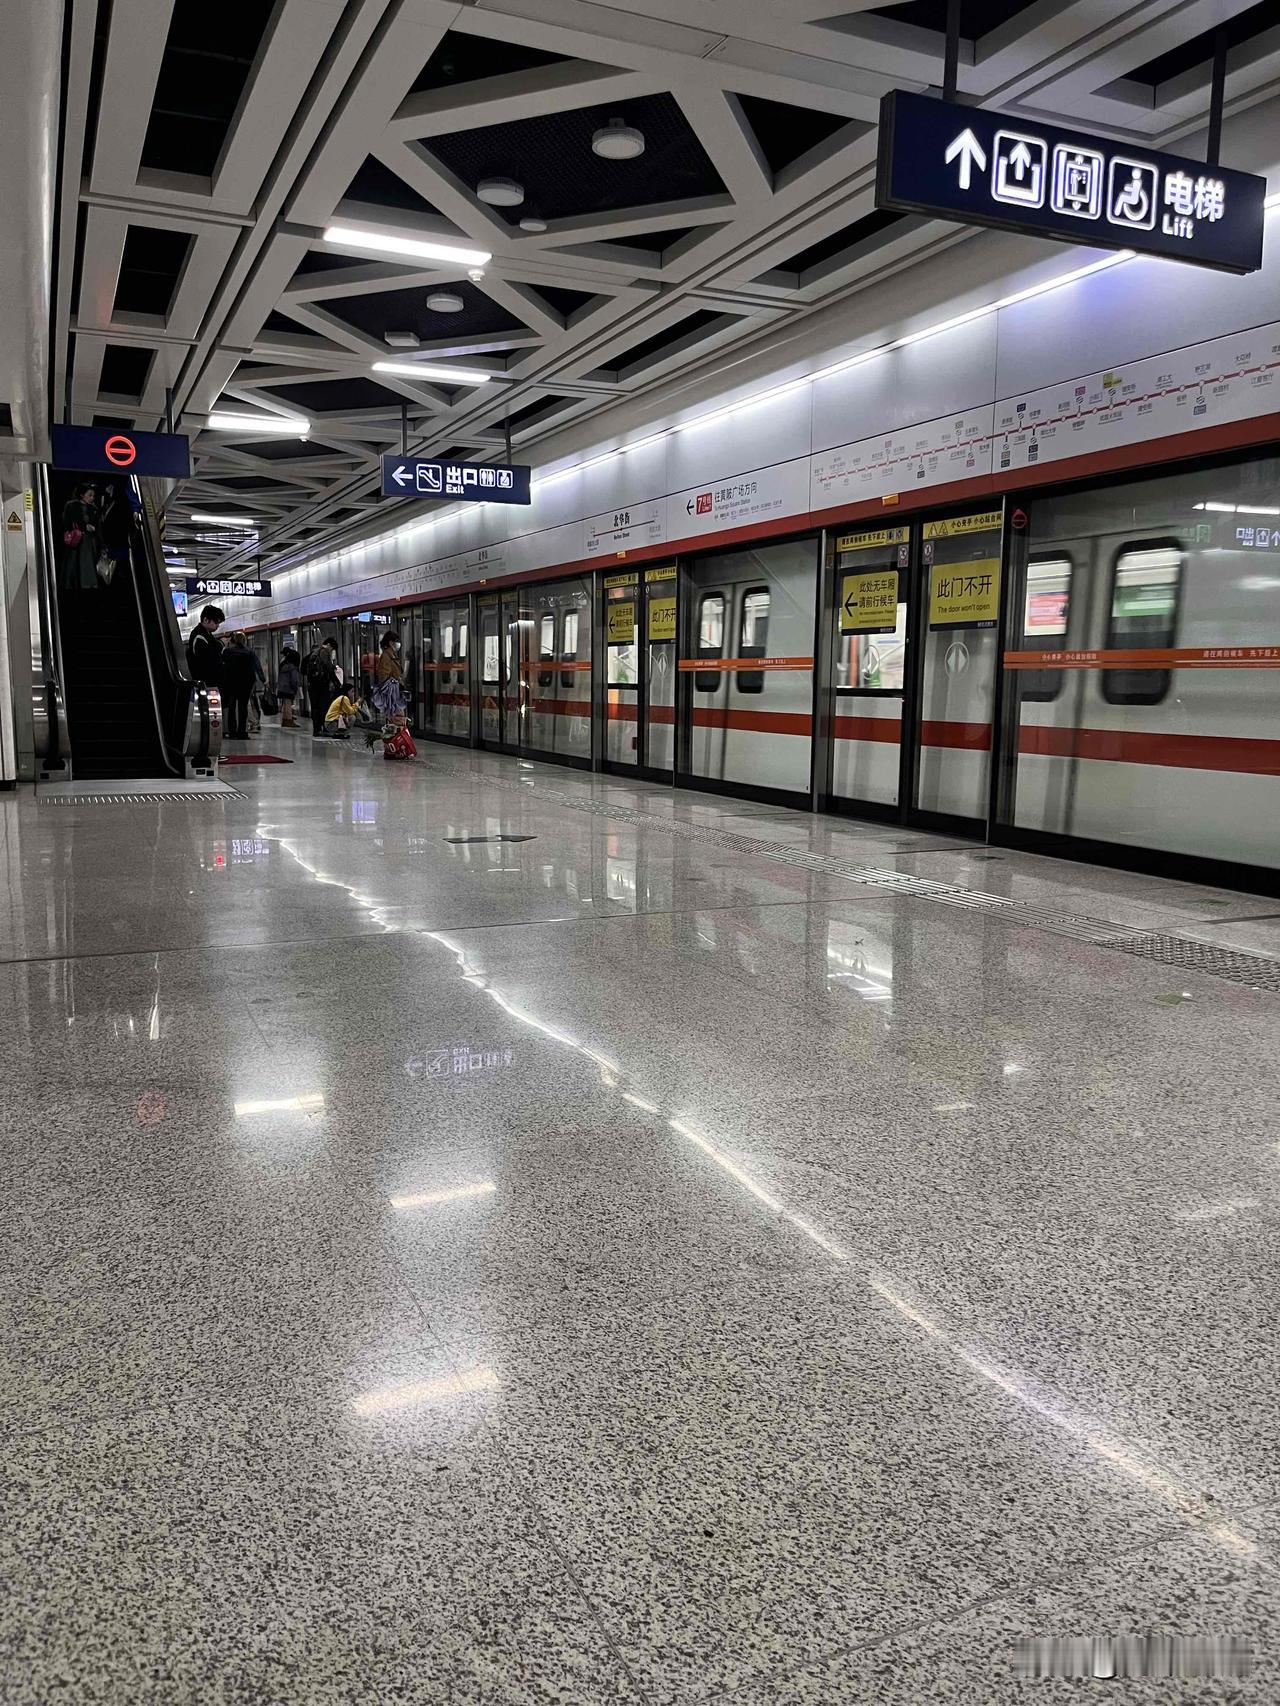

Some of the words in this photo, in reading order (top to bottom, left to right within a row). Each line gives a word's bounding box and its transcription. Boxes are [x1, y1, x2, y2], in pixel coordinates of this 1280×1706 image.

[1164, 170, 1225, 222] 电梯
[1162, 214, 1193, 239] Lift
[446, 466, 477, 485] 出口
[446, 484, 464, 494] Exit
[859, 578, 895, 592] 此处无车厢
[937, 575, 992, 598] 此门不开
[859, 595, 895, 608] 请前行候车
[938, 606, 947, 614] The
[948, 604, 960, 613] door
[961, 604, 975, 612] won't
